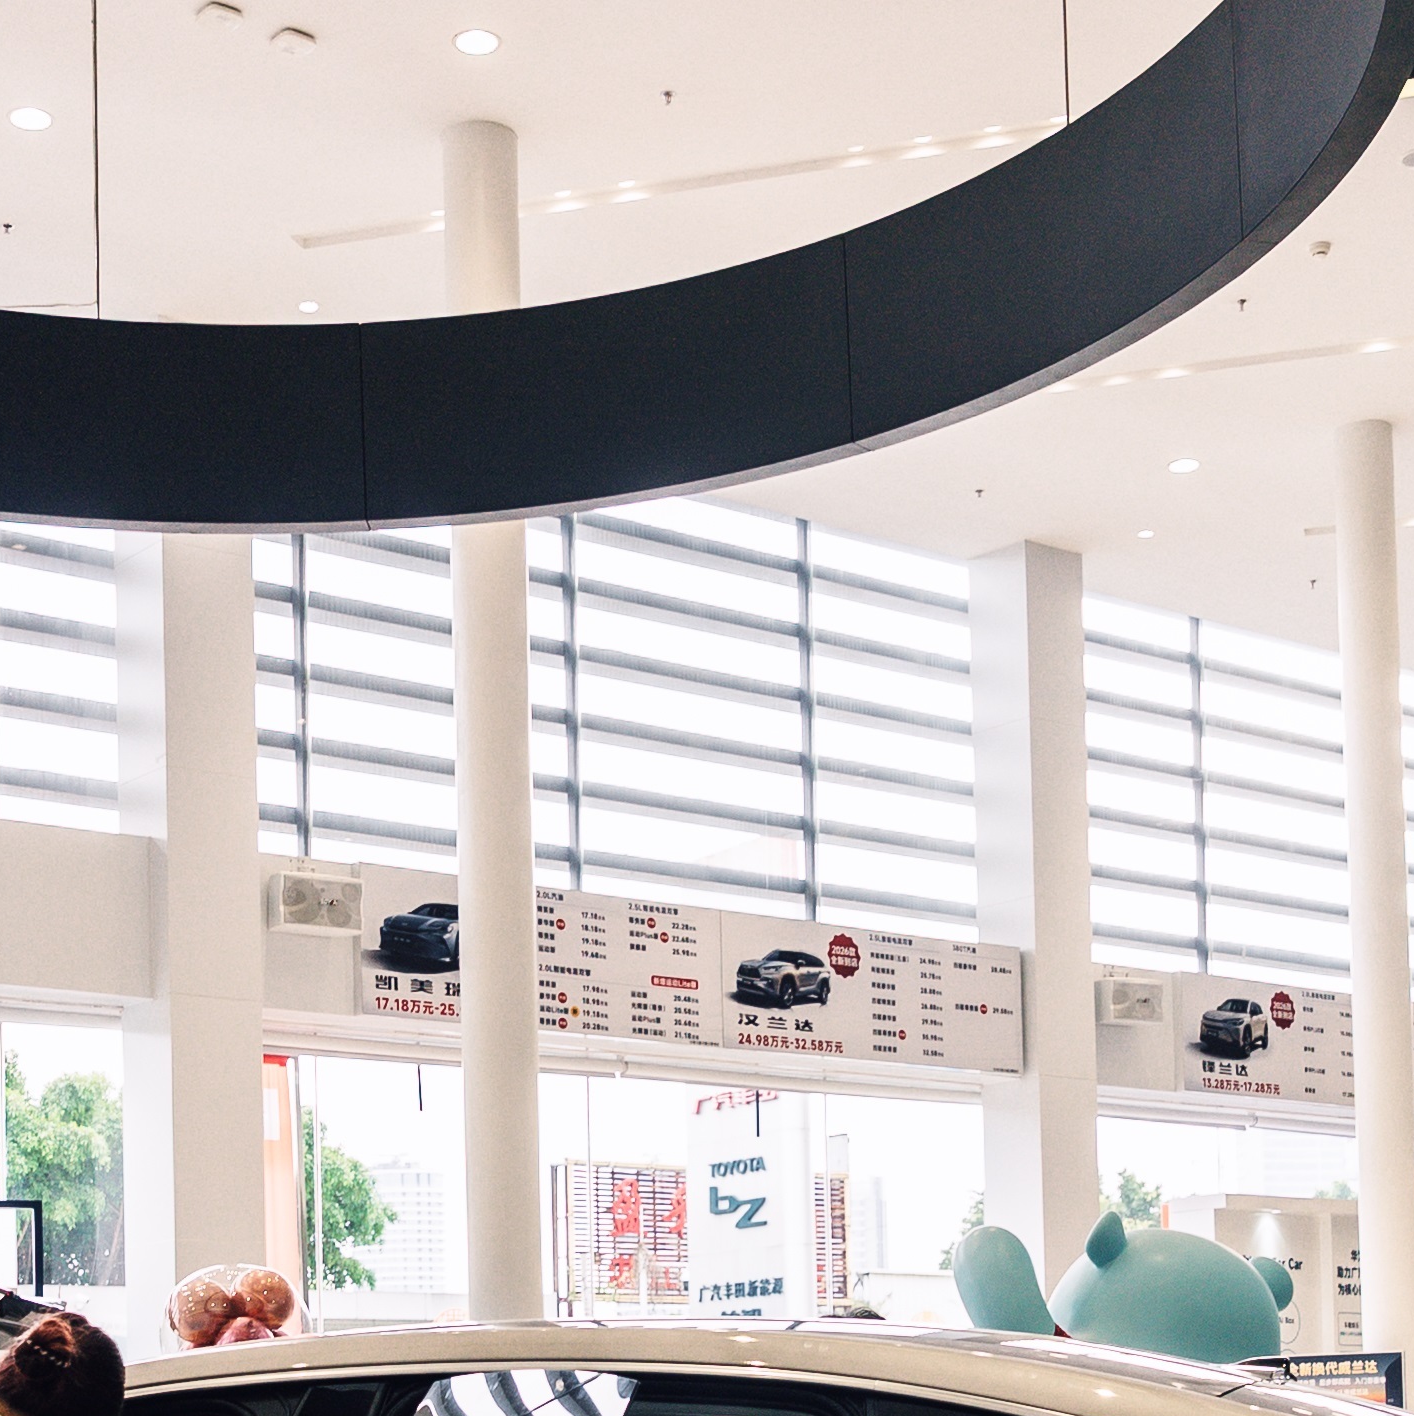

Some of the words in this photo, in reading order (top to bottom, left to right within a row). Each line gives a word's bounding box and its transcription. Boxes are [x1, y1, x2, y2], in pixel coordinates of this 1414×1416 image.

[738, 1013, 813, 1032] 汉兰达
[738, 1033, 843, 1053] 24.98万元-32.58万元
[1202, 1078, 1280, 1095] 13.28万元-17.28万元
[709, 1157, 766, 1178] TOYOTA
[1288, 1258, 1303, 1269] Car
[699, 1277, 784, 1302] 广汽丰田新能源
